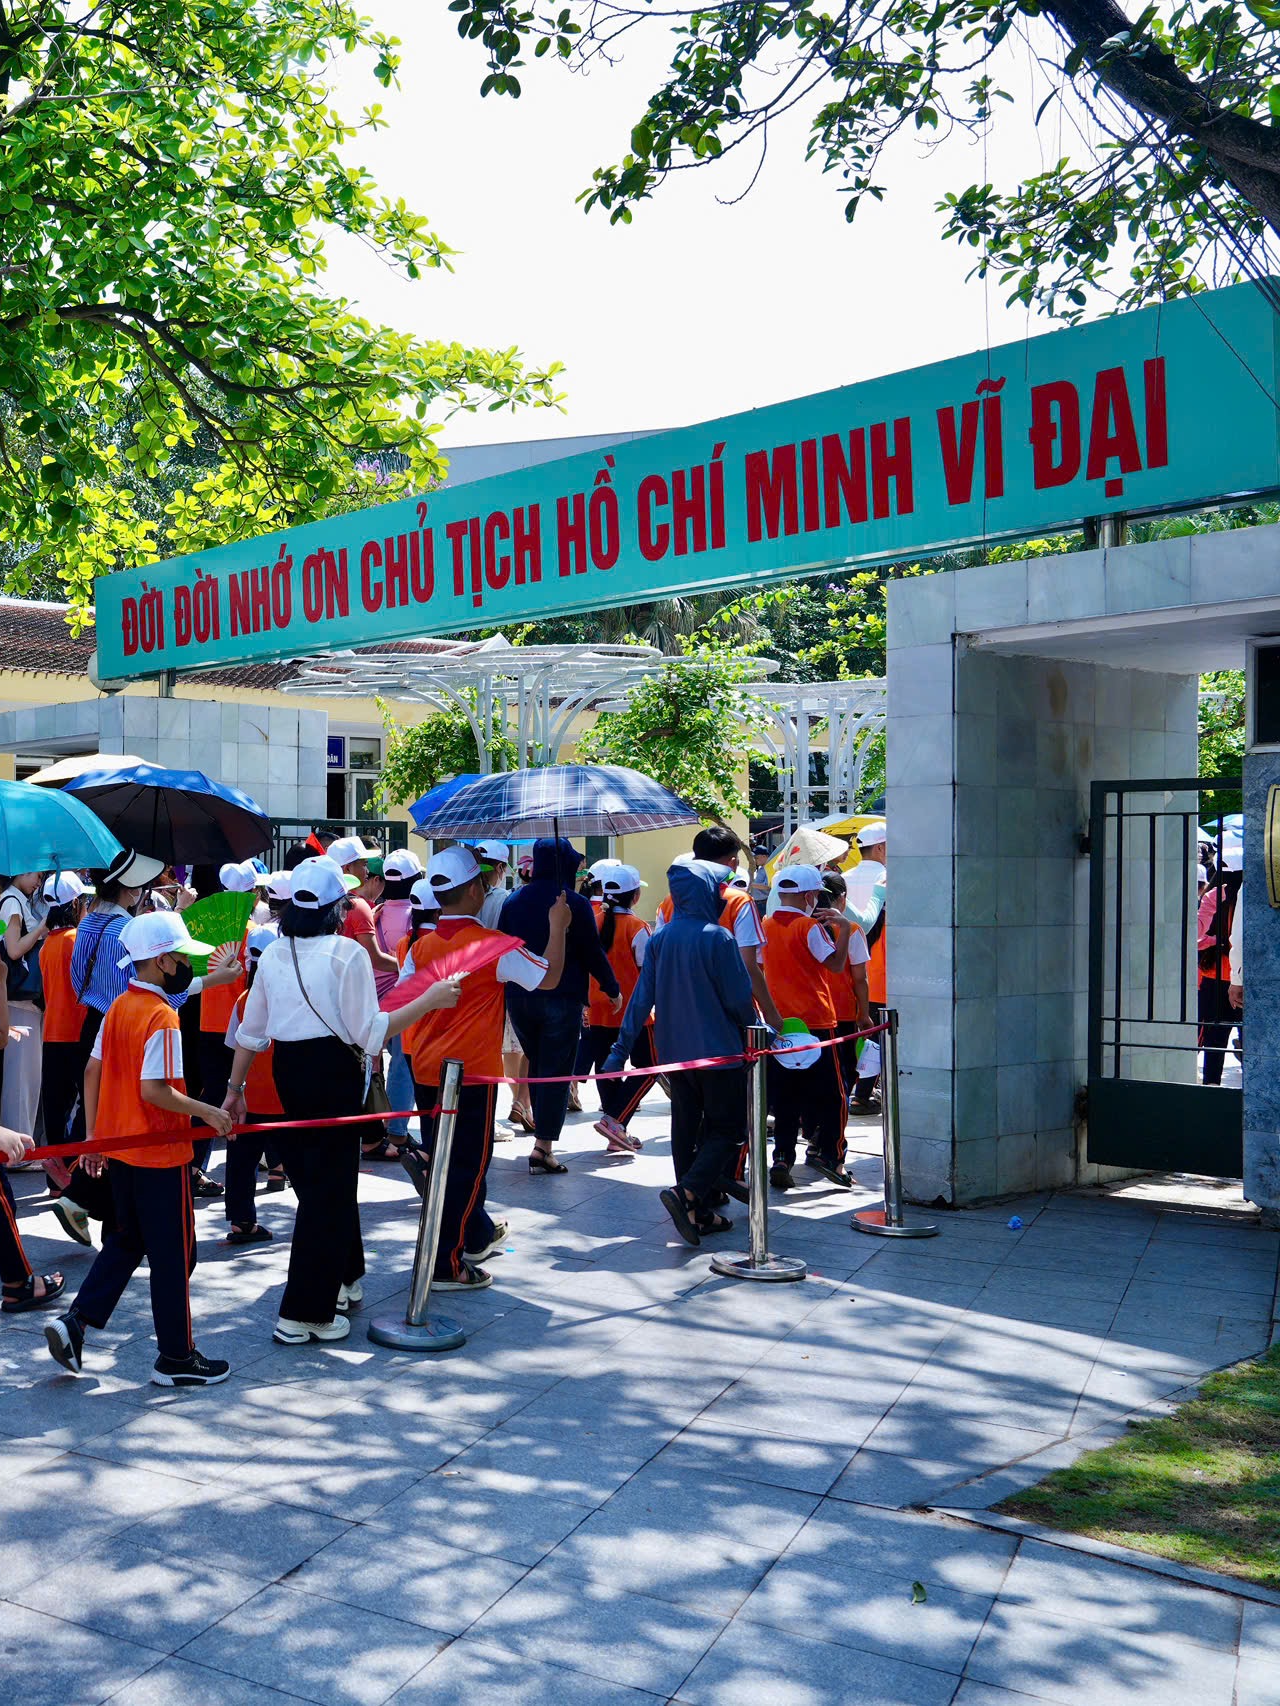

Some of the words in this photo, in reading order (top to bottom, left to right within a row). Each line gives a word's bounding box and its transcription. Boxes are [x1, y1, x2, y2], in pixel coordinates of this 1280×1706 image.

[121, 581, 164, 656] ĐỜI
[174, 568, 220, 647] ĐỜI
[230, 544, 293, 636] NHỚ
[302, 547, 350, 623] ƠN
[361, 502, 435, 613] CHỦ
[446, 504, 542, 608] TỊCH
[557, 456, 621, 577] HỒ
[637, 442, 726, 562] CHÍ
[745, 417, 914, 543] MINH
[936, 376, 1006, 505] VĨ
[1029, 356, 1168, 497] ĐẠI
